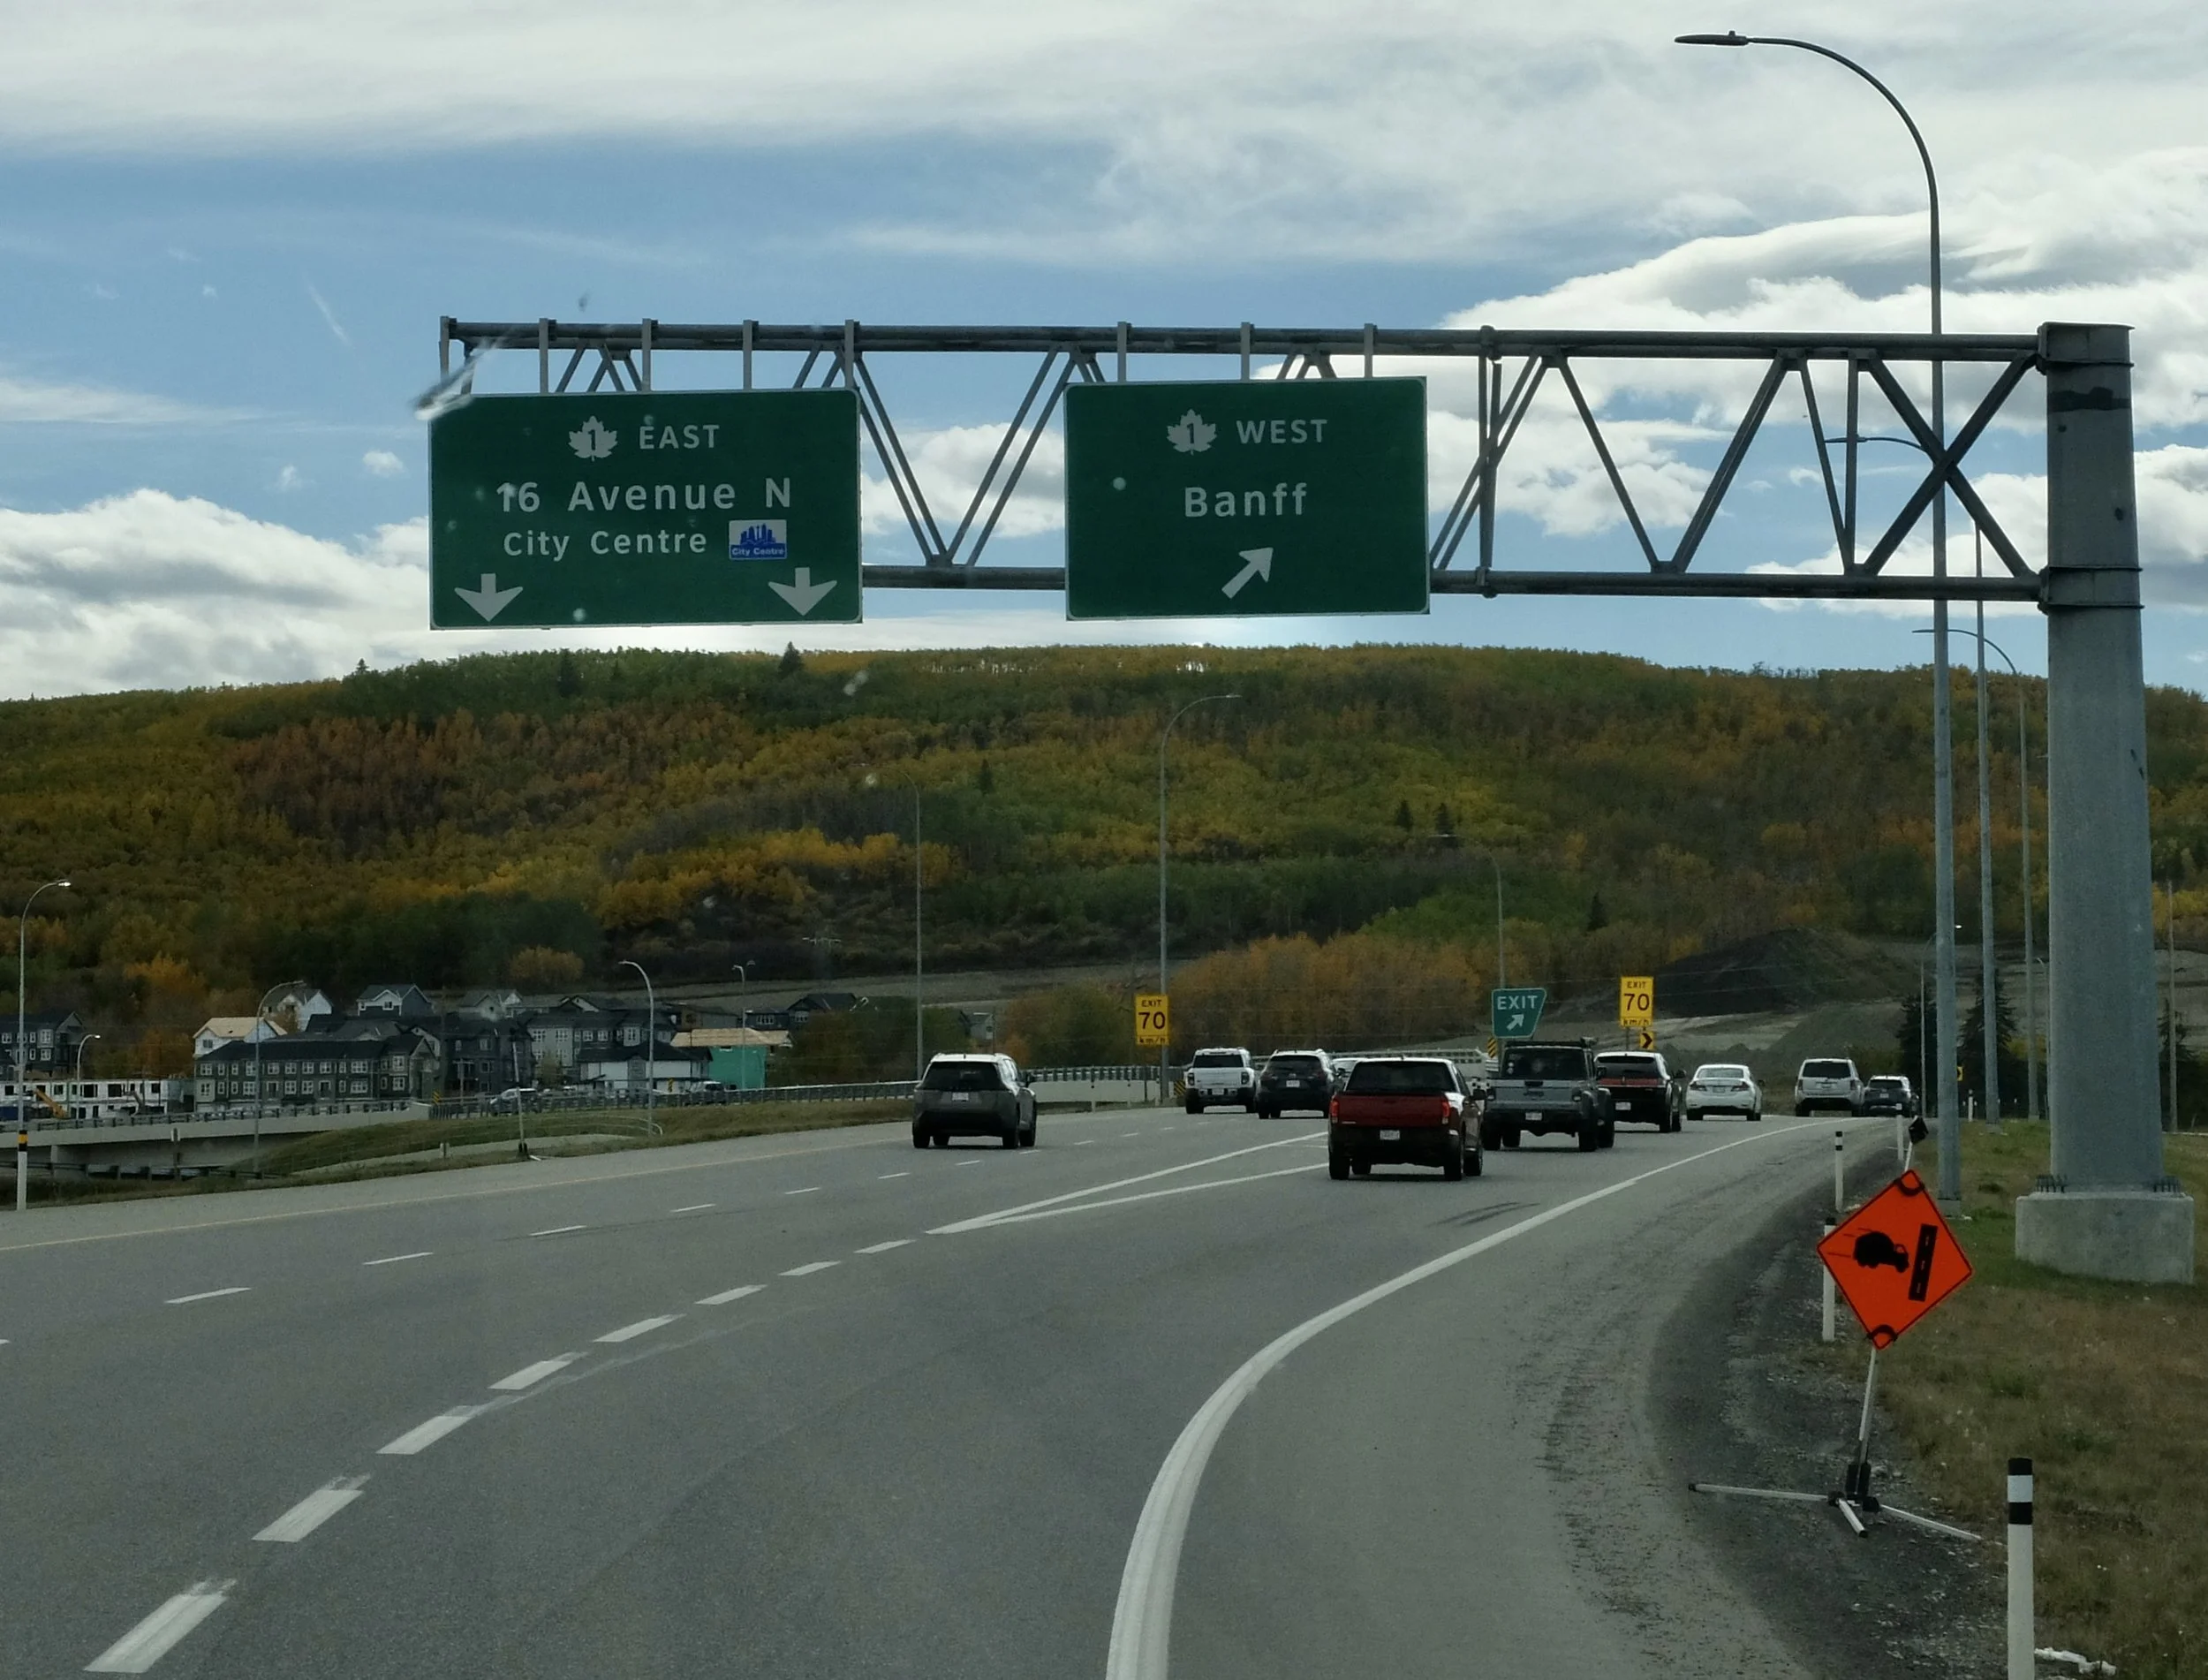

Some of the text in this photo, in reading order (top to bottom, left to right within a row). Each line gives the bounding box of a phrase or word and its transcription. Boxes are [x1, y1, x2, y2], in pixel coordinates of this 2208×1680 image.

[586, 424, 720, 452] 1 EAST
[1185, 419, 1327, 445] 1 WEST
[496, 478, 790, 512] 16 Avenue N
[1184, 482, 1307, 518] Banff
[503, 530, 707, 562] City Centre
[1497, 995, 1539, 1010] EXIT
[1623, 993, 1650, 1011] 70
[1138, 1011, 1166, 1030] 70
